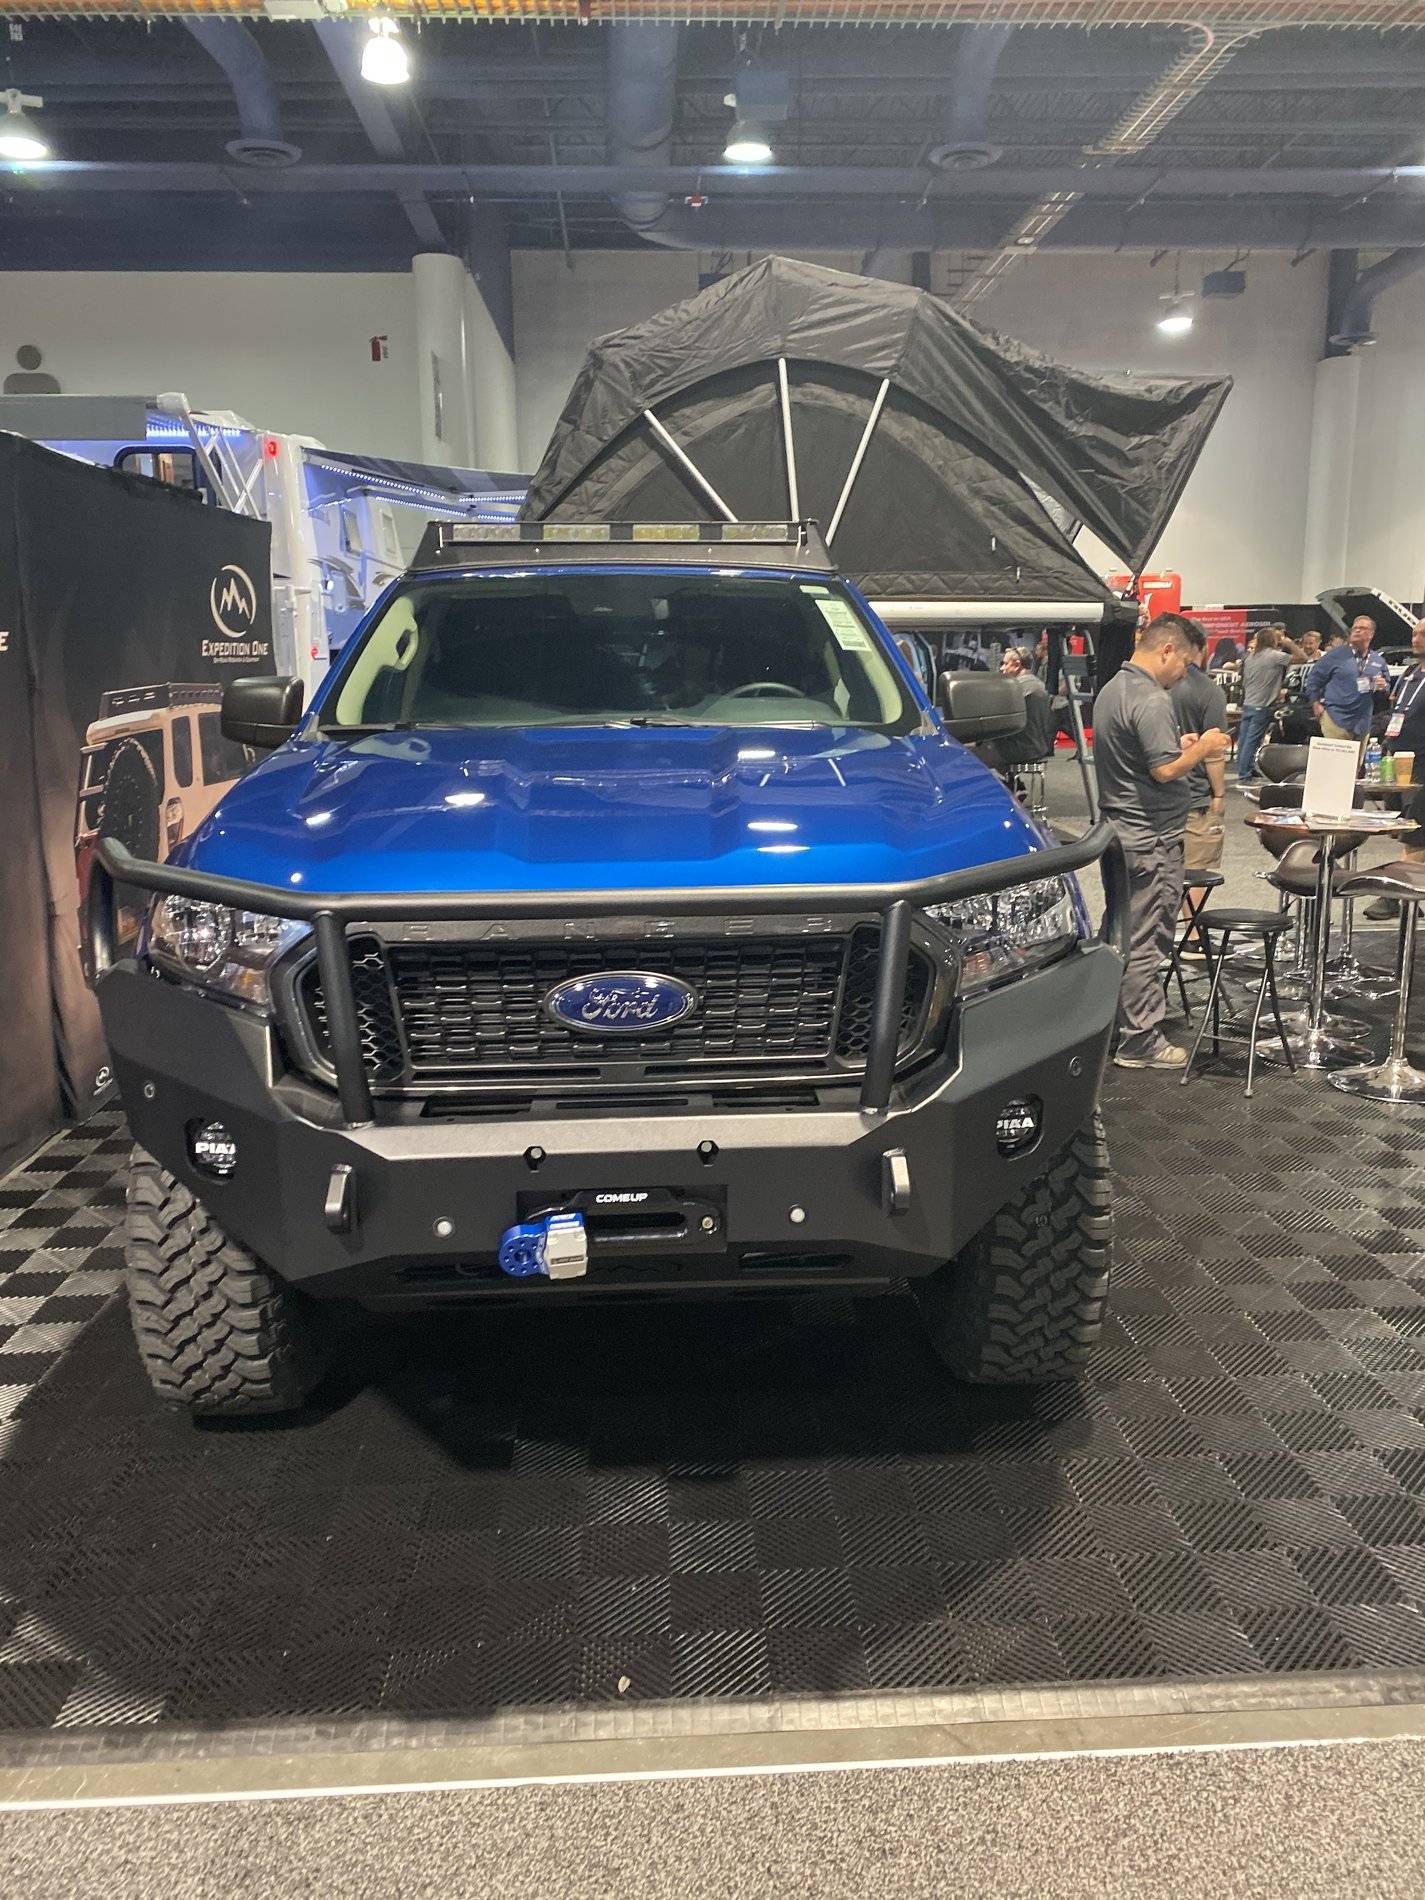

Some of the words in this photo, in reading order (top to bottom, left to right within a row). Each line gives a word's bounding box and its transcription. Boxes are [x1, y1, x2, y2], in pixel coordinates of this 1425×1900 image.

[401, 916, 834, 942] RANGER
[581, 987, 661, 1020] Ford
[595, 1192, 648, 1204] COMEUP
